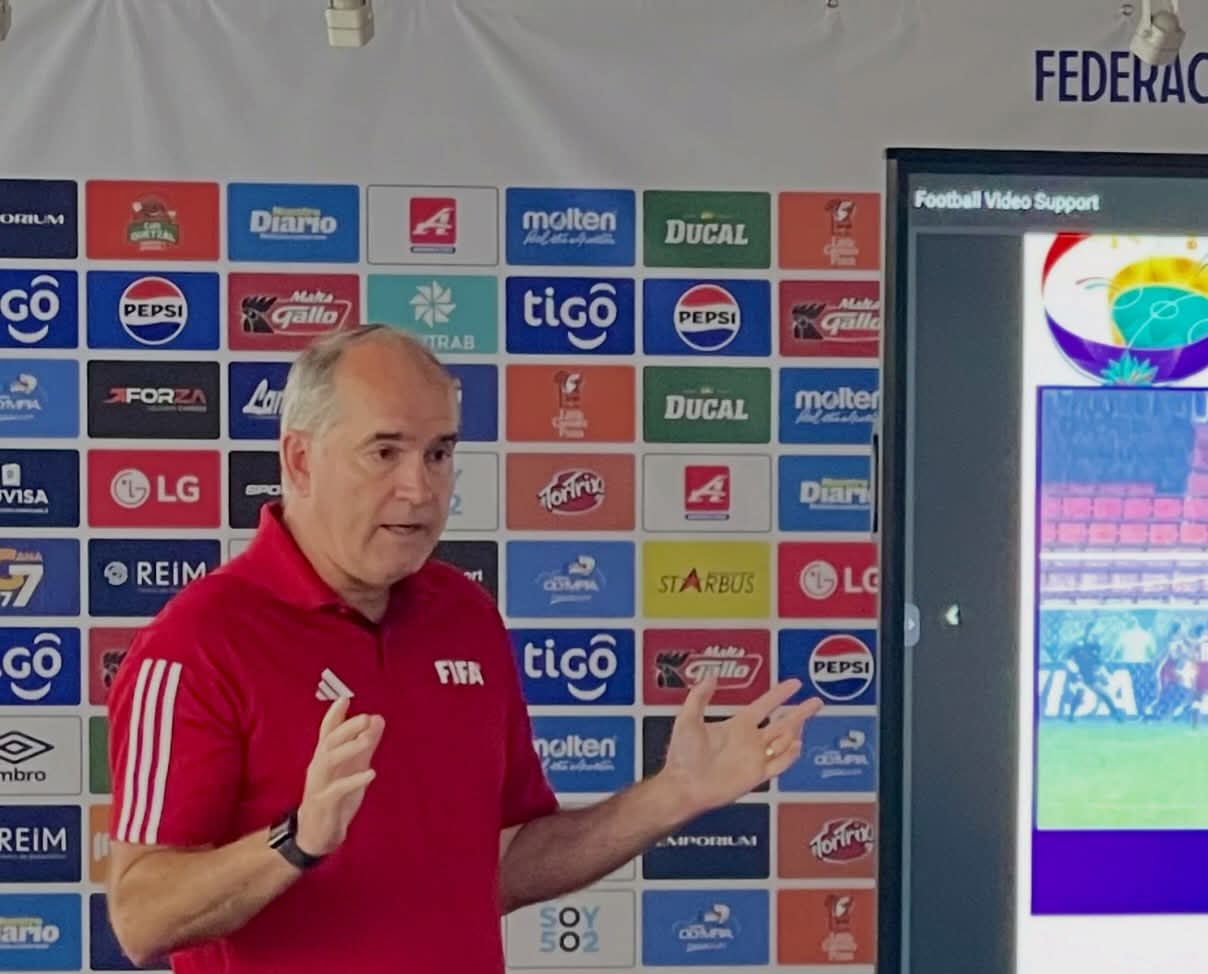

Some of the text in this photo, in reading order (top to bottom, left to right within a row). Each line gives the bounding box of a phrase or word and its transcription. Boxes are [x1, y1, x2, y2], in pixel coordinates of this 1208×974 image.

[915, 190, 1100, 214] Football Video Support
[249, 209, 337, 234] Diario
[522, 208, 617, 231] molten
[290, 290, 333, 303] Malta
[124, 304, 183, 318] PEPSI
[679, 310, 737, 325] PEPSI
[126, 388, 207, 404] FORZA
[158, 475, 200, 502] LG
[658, 567, 755, 594] STARBUS
[434, 660, 485, 686] FIFA
[814, 659, 870, 674] PEPSI
[539, 906, 600, 929] SOY
[539, 931, 600, 953] 502
